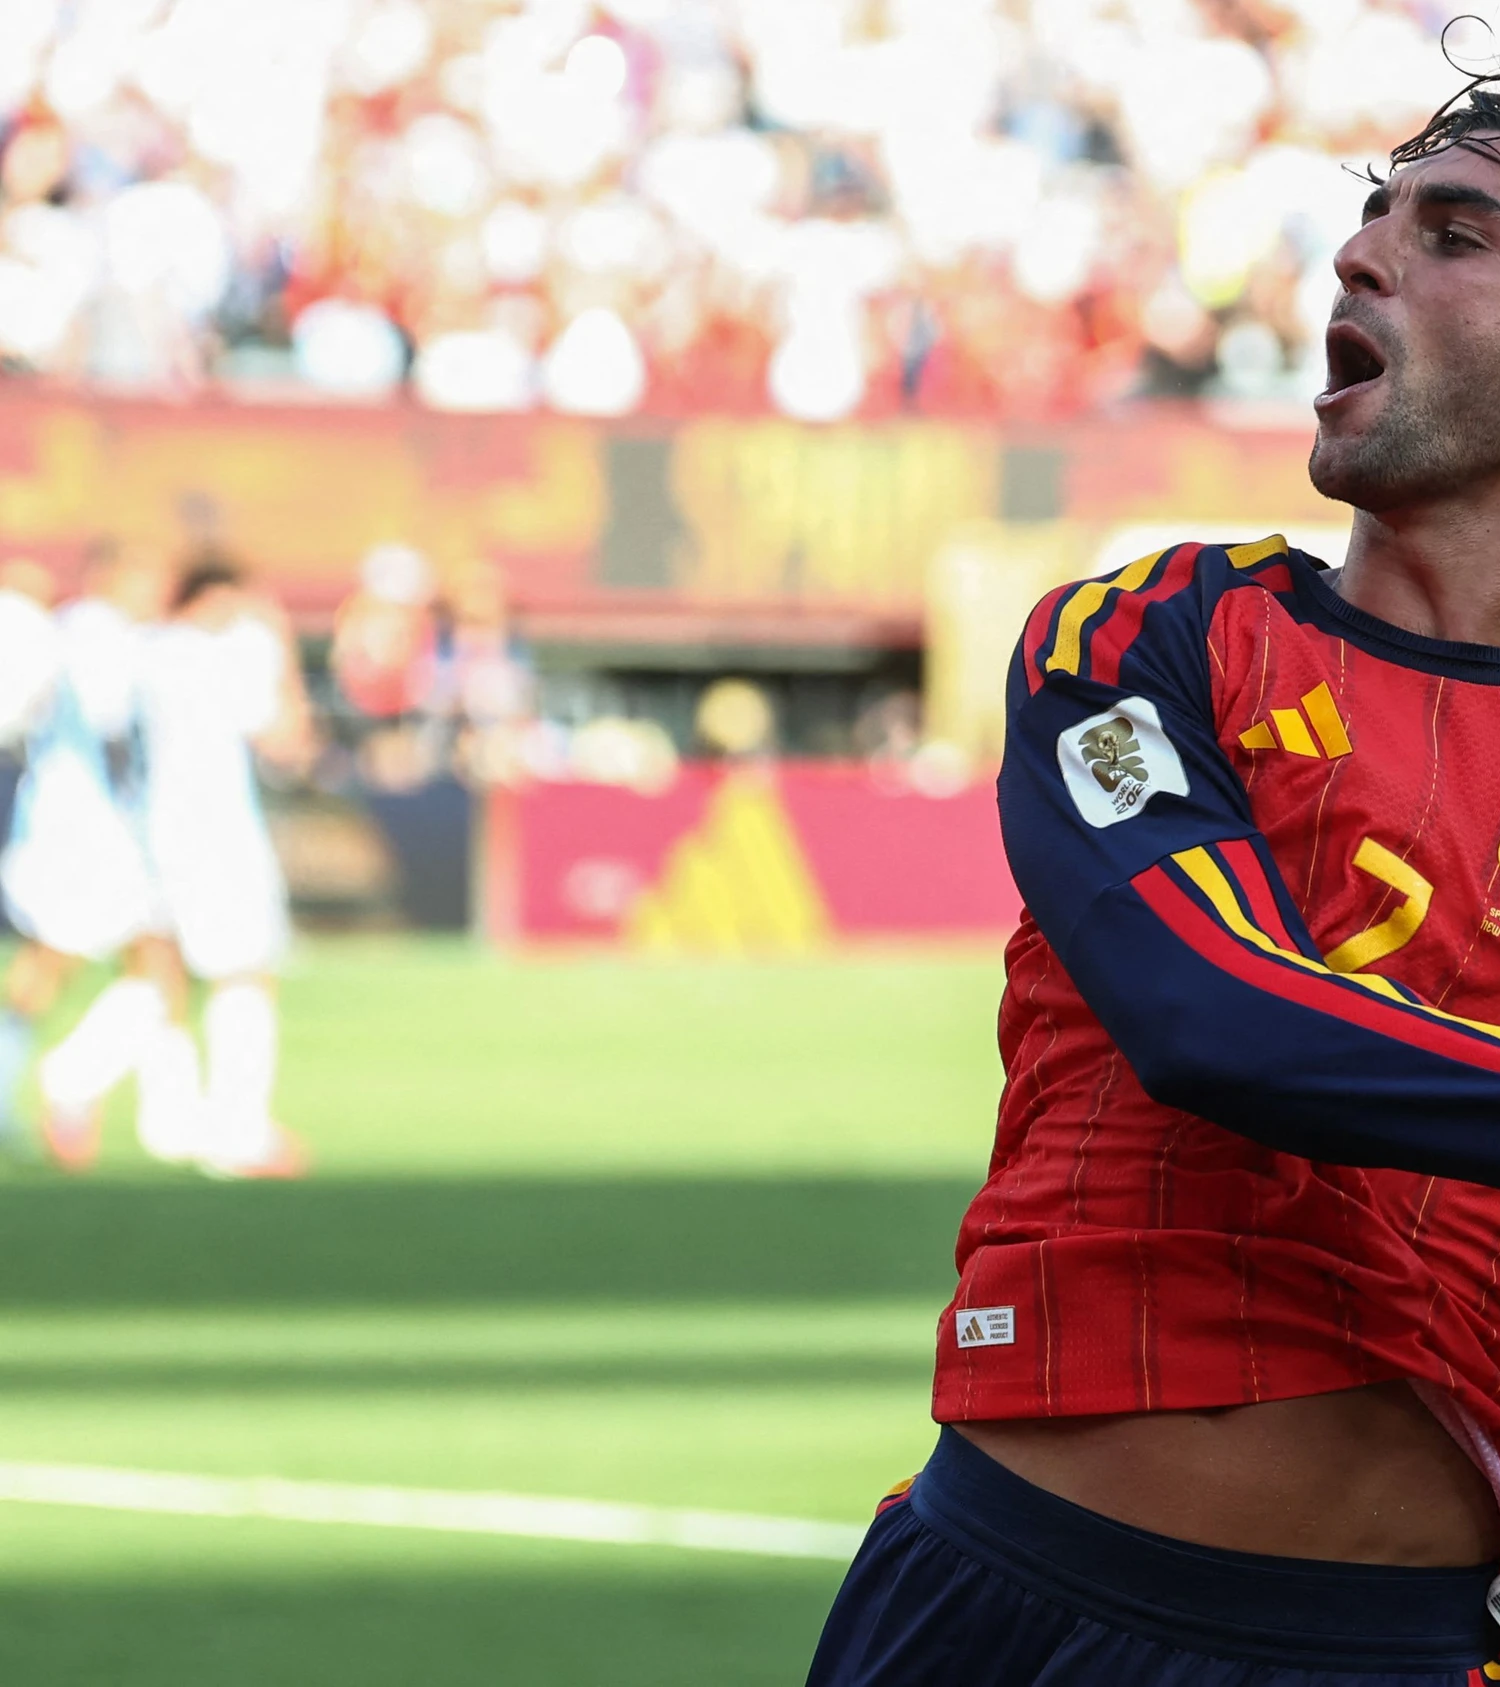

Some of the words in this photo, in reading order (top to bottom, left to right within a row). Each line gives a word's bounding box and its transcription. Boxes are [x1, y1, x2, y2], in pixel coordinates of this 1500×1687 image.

[1109, 769, 1130, 781] FI
[1111, 779, 1134, 806] WORLD
[1115, 782, 1150, 815] 202
[1323, 836, 1435, 973] 7
